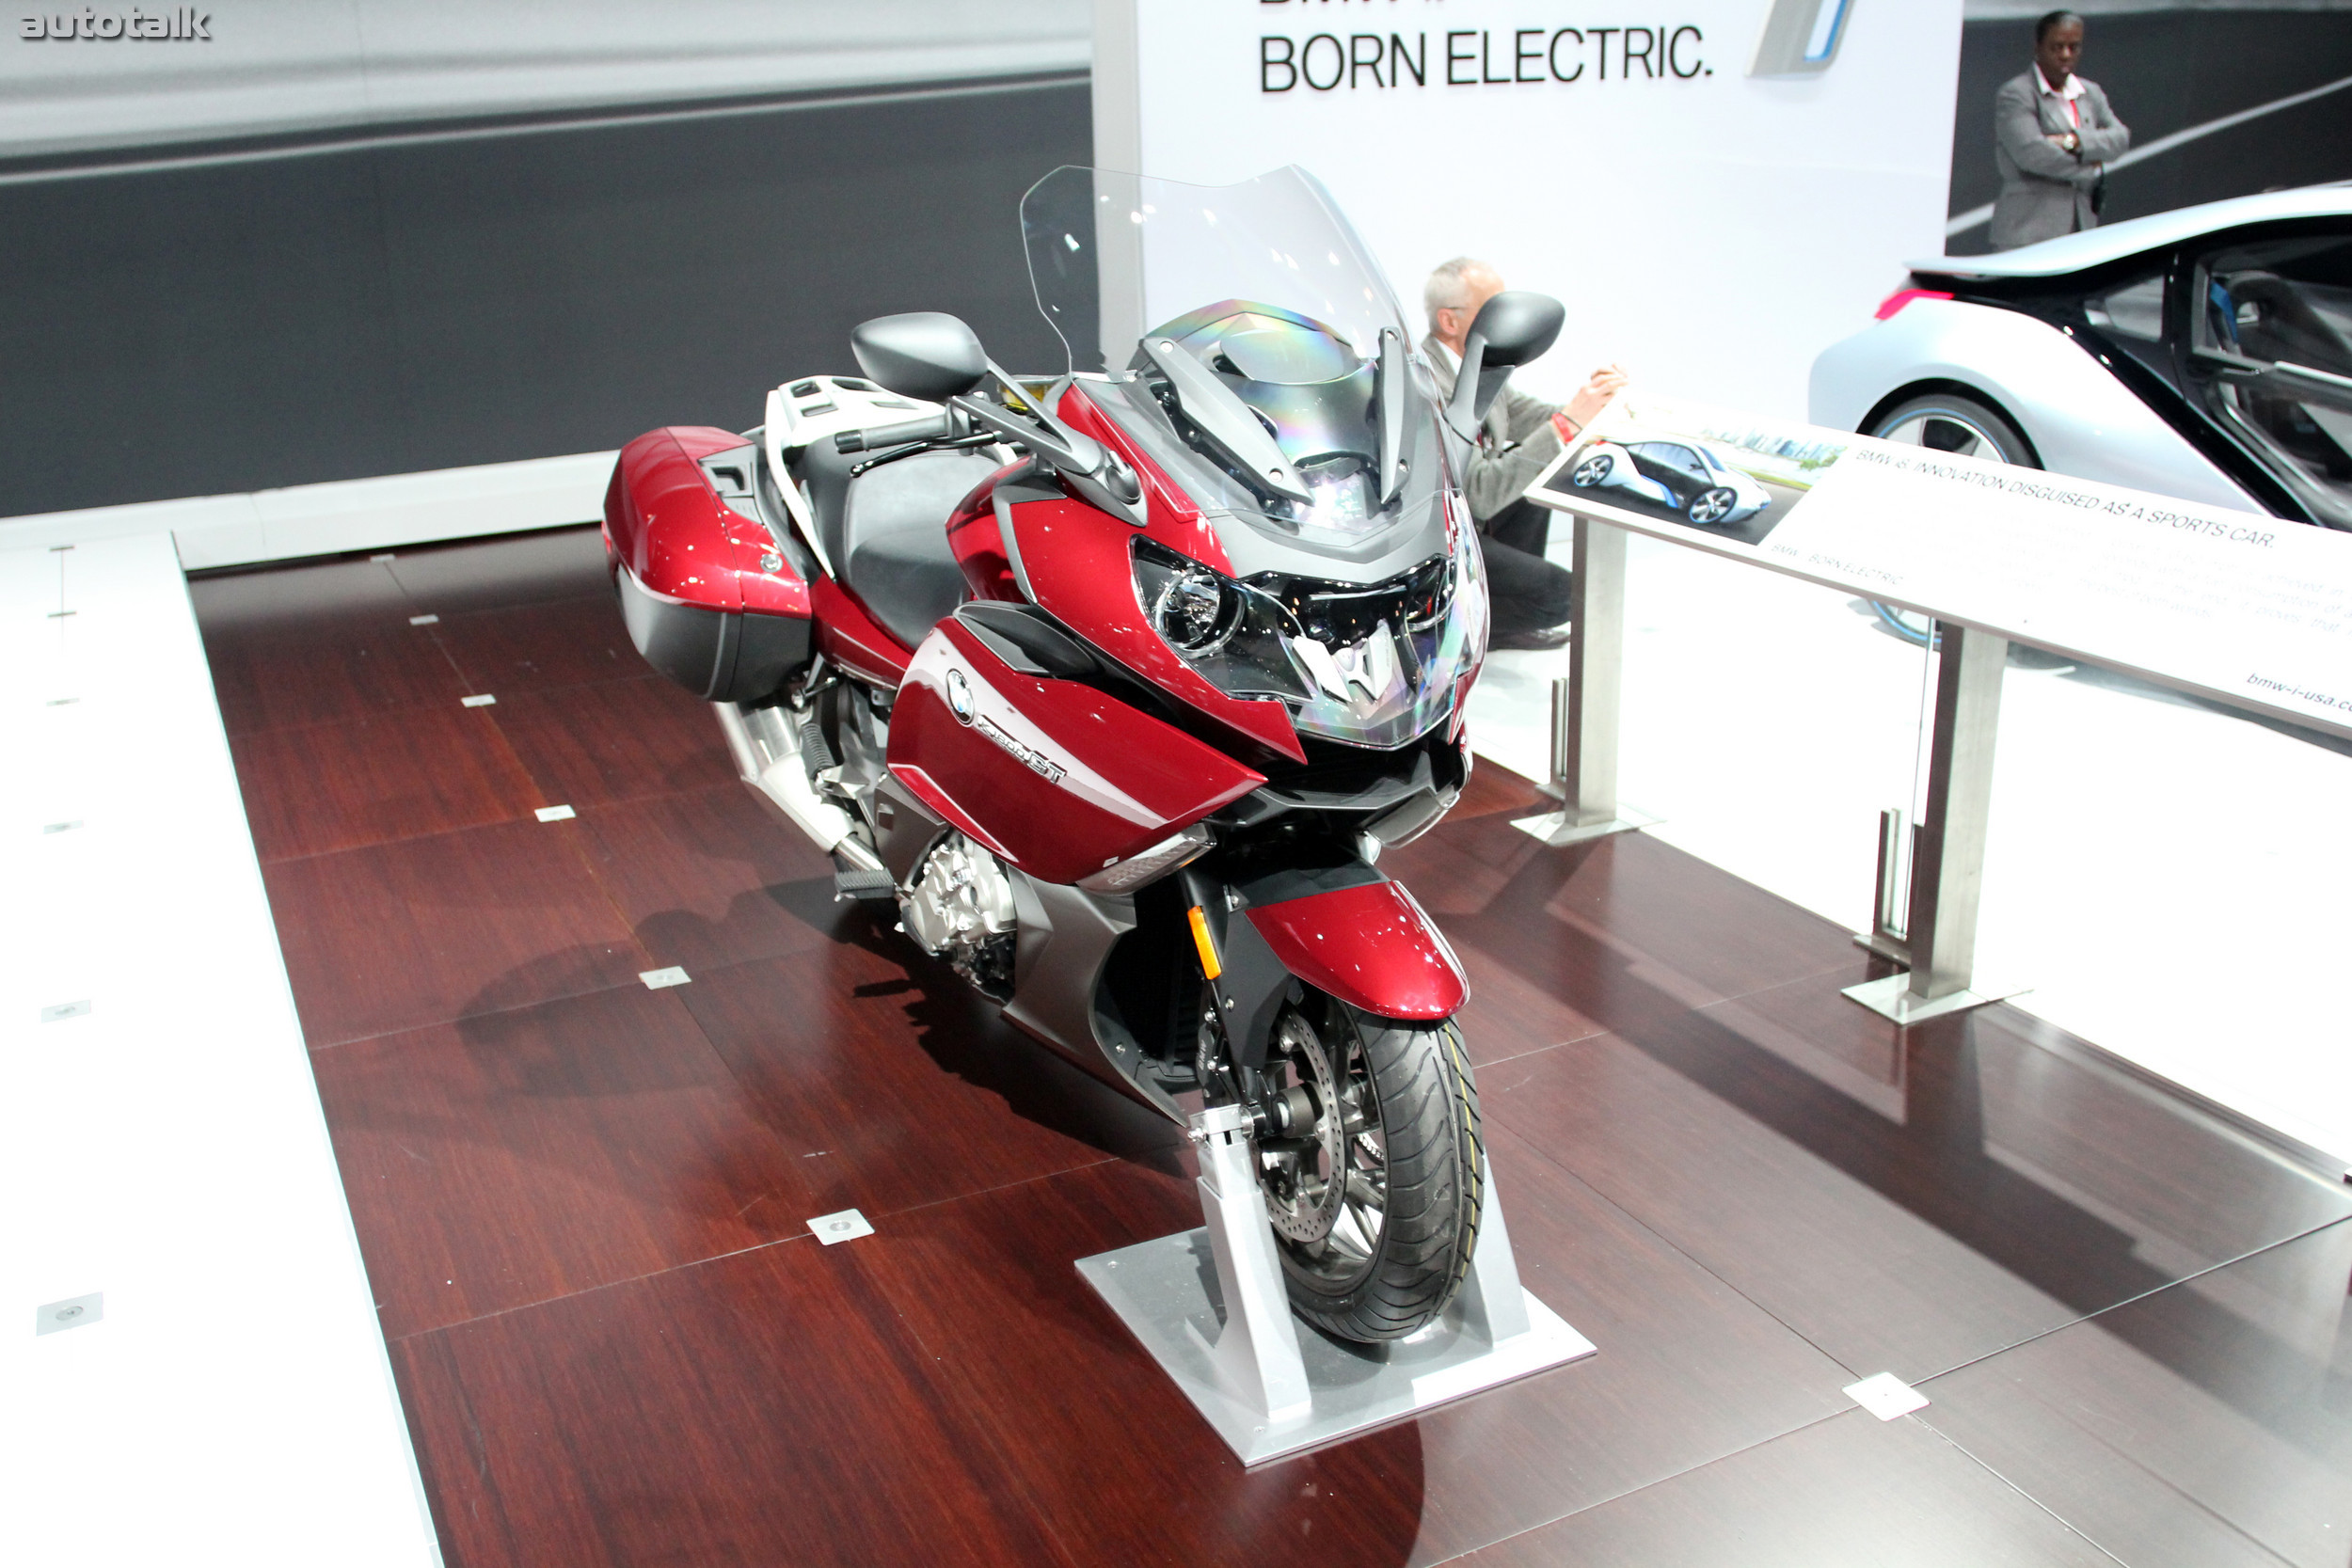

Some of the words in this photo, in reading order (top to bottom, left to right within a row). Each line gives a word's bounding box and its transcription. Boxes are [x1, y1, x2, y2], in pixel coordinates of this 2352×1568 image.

[1260, 32, 1426, 93] BORN
[1446, 25, 1713, 86] ELECTRIC.
[1856, 450, 1893, 466] BMW
[1913, 462, 2009, 490] INNOVATION
[2009, 481, 2100, 509] DISGUISED
[2101, 501, 2128, 516] AS
[2129, 507, 2145, 520] A
[2147, 511, 2228, 538] SPORTS
[2230, 528, 2275, 549] CAR.
